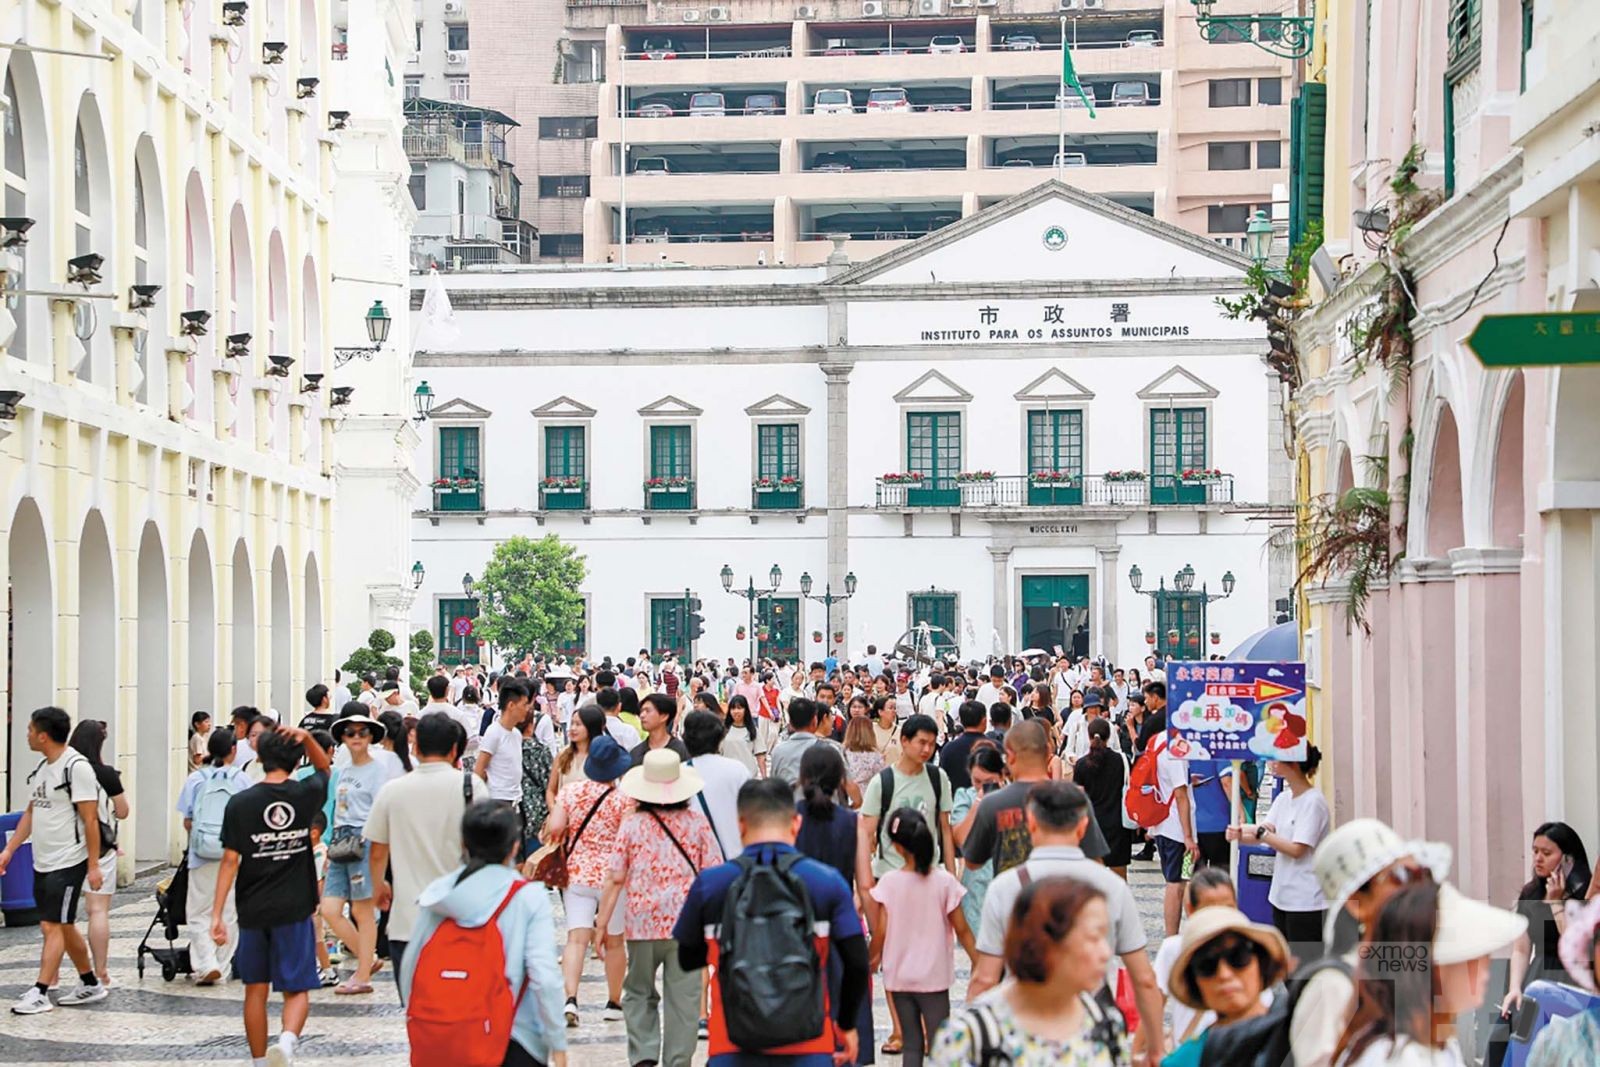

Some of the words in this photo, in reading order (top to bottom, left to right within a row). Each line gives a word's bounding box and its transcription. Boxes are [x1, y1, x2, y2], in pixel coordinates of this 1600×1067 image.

[979, 303, 1131, 325] 市政署
[921, 329, 981, 341] INSTITUTO
[989, 329, 1019, 340] PARA
[1027, 328, 1043, 339] OS
[1051, 327, 1113, 339] ASSUNTOS
[1121, 325, 1190, 337] MUNICIPAIS
[250, 828, 309, 843] VOLCOM
